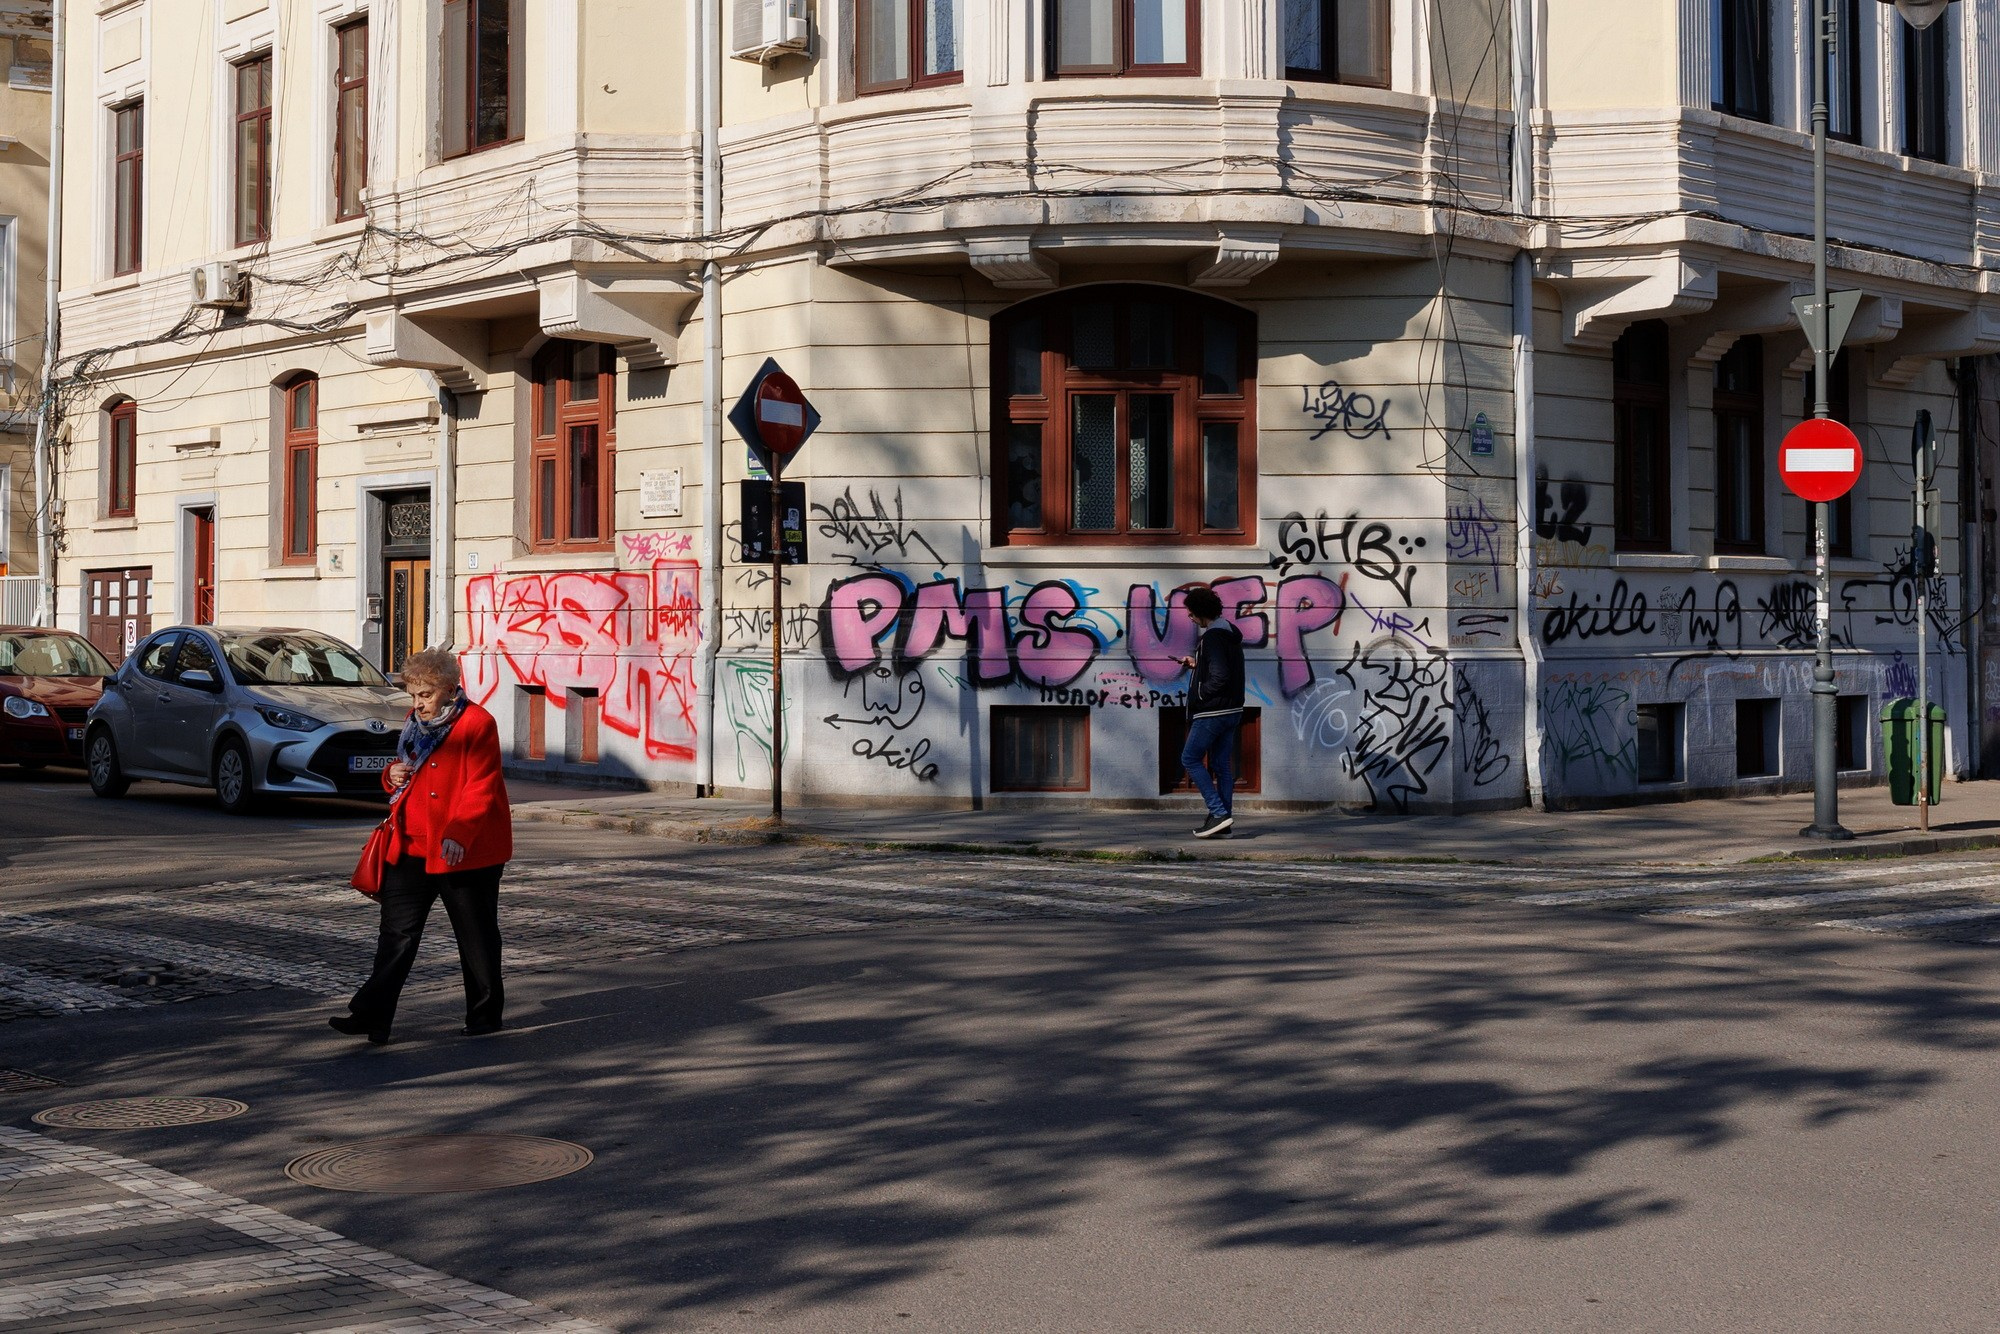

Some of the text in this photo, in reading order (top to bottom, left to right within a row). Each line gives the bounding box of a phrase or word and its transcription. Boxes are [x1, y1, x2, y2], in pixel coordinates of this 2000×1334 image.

[1041, 675, 1109, 708] honor
[1120, 689, 1144, 709] et
[1149, 689, 1188, 708] Pat
[366, 757, 385, 769] 250
